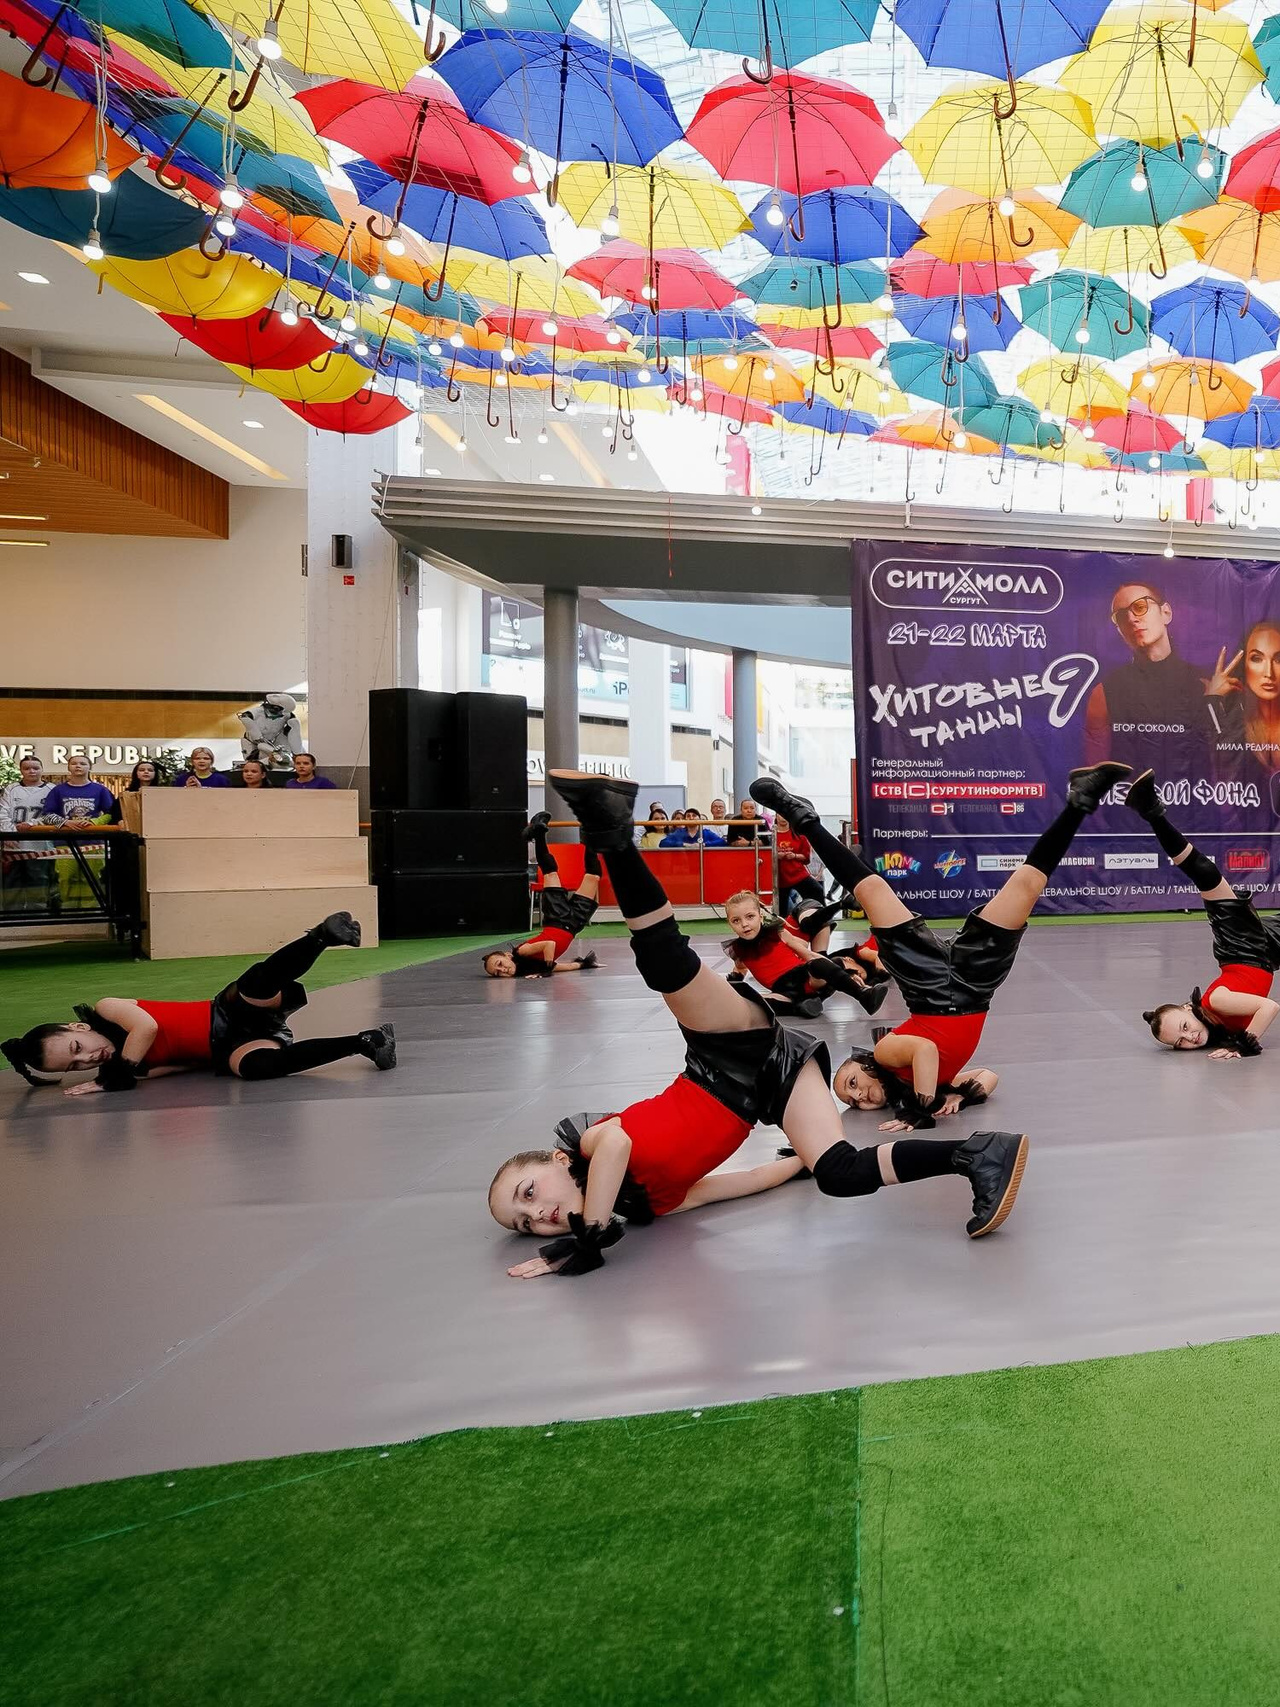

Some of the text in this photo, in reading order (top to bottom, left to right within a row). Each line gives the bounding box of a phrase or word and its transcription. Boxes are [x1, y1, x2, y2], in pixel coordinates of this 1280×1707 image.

[950, 597, 981, 605] СУРГУТ
[887, 622, 1047, 649] 21-22 МАРТА
[868, 674, 1046, 728] ХИТОВЫЕ
[909, 704, 1023, 748] ТАНЦЫ
[1113, 723, 1185, 733] ЕГОР СОКОЛОВ
[1216, 743, 1280, 752] МИЛА РЕДИНА
[872, 758, 944, 769] Генеральный
[872, 768, 1026, 780] информационный партнер:
[1193, 778, 1261, 808] ФОНД
[873, 828, 929, 840] Партнеры:
[887, 869, 908, 878] парк
[939, 889, 965, 899] ШОУ
[1098, 886, 1122, 896] ШОУ
[1131, 885, 1166, 895] БАТТЛЫ
